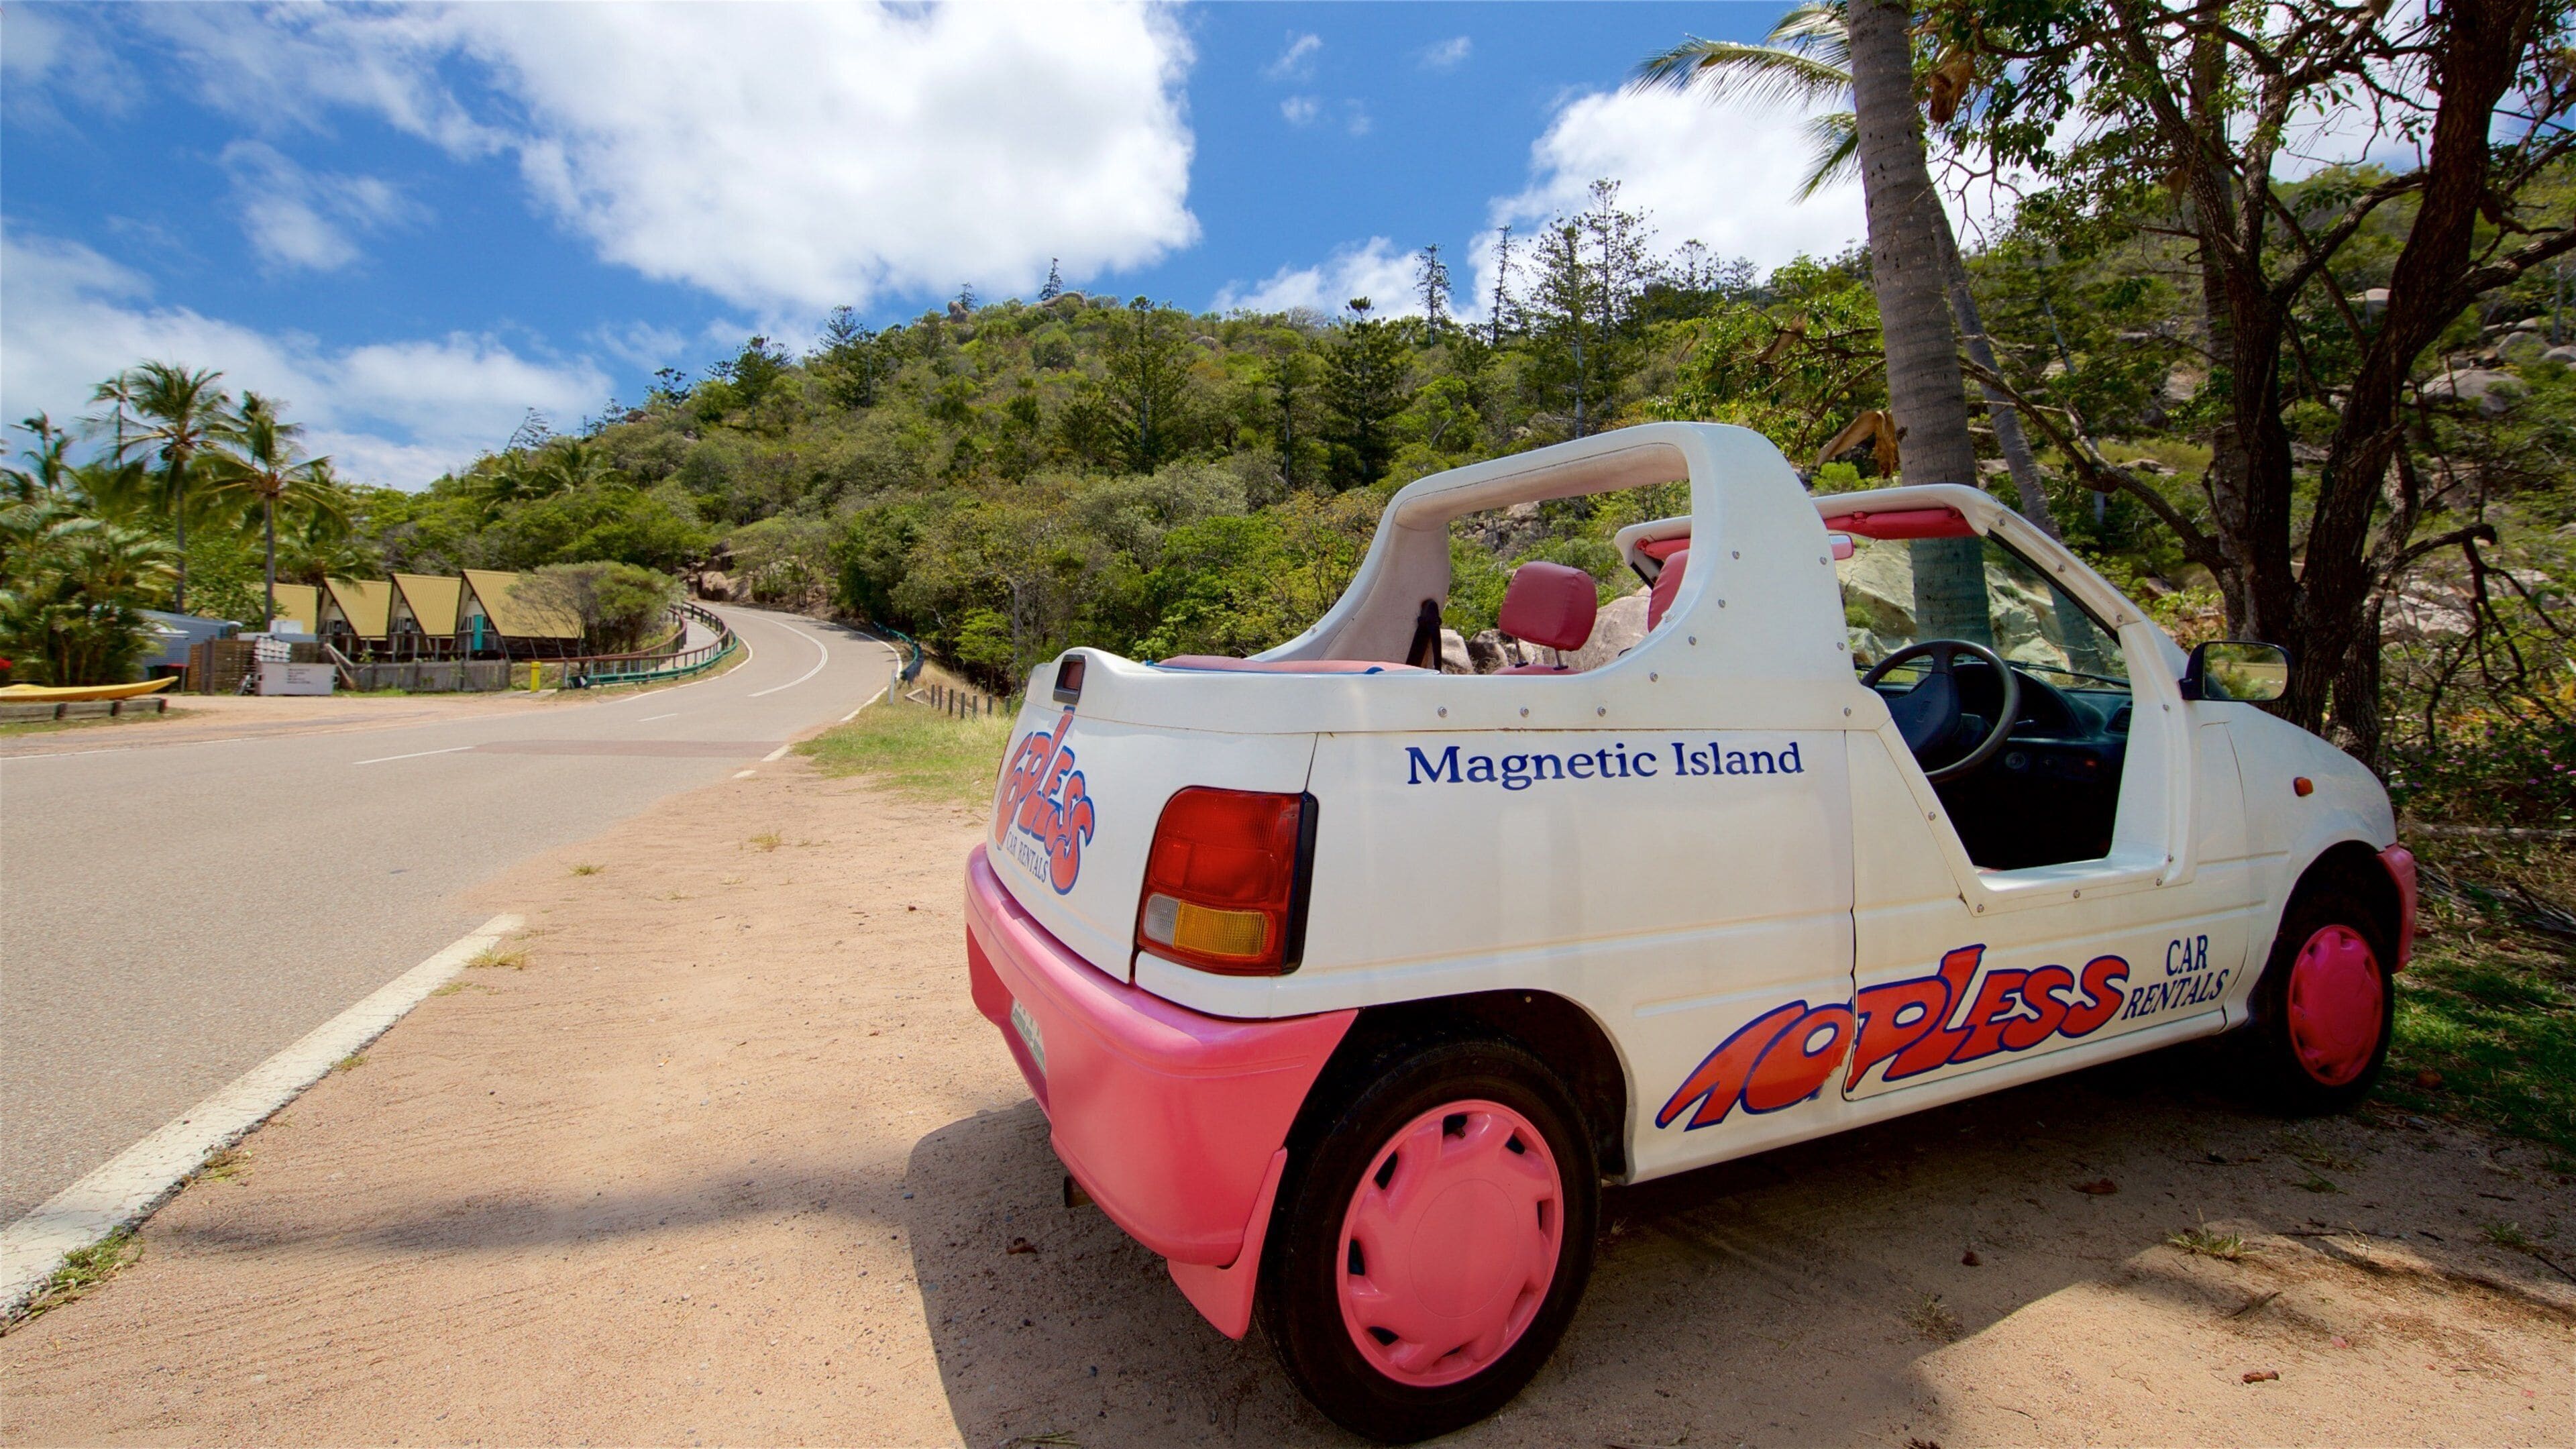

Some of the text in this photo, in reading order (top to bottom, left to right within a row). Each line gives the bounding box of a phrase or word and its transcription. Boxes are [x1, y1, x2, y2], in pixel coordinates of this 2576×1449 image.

[1405, 741, 1805, 791] Magnetic Island
[1006, 832, 1049, 883] CAR RENTALS
[2166, 934, 2208, 976] CAR
[2121, 969, 2229, 1020] RENTALS
[1655, 943, 2130, 1132] TOPLESS
